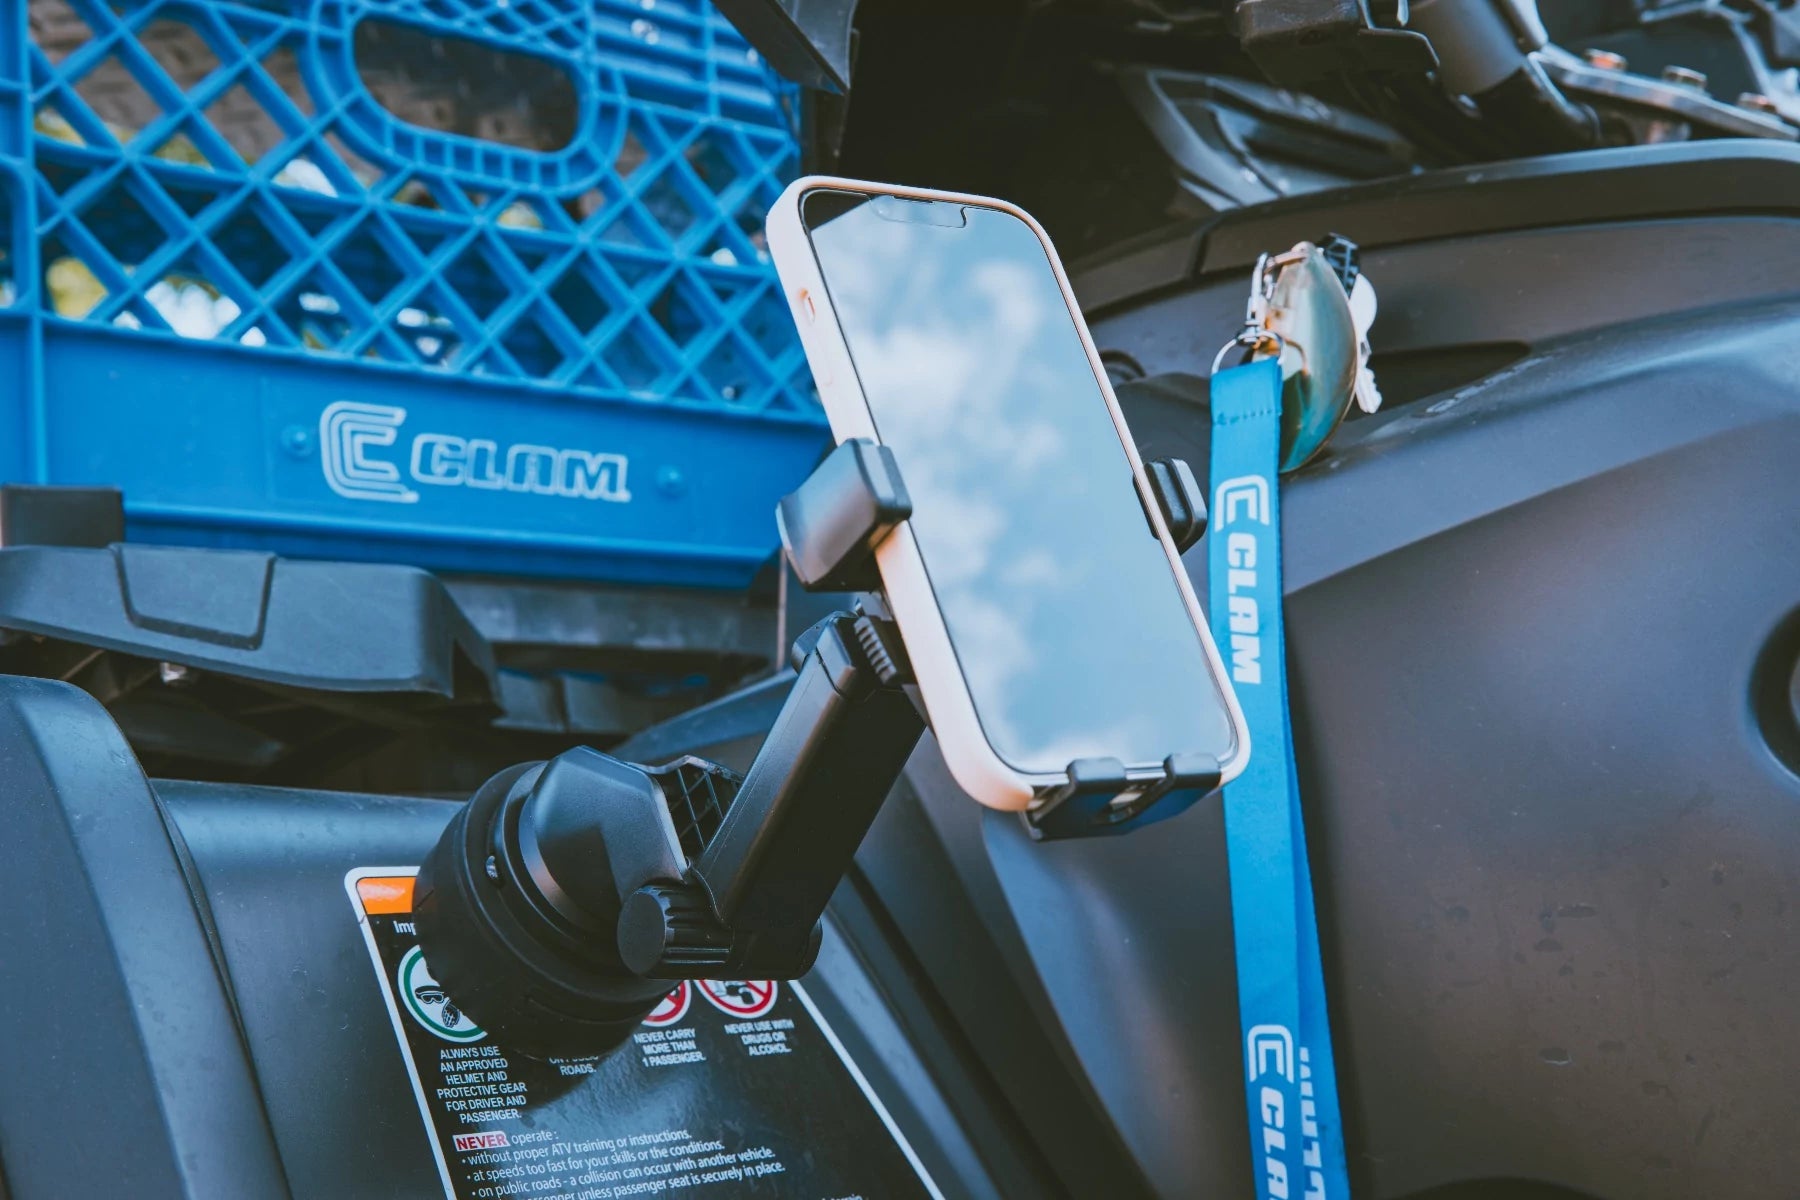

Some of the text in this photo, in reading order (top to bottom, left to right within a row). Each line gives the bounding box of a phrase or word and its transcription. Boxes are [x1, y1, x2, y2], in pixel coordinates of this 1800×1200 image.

[410, 433, 631, 502] CLAM
[1228, 532, 1261, 685] CLAM
[724, 1019, 794, 1035] NEVER USE WITH
[634, 1028, 696, 1044] NEVER CARRY
[741, 1031, 786, 1045] DRUGS OR
[440, 1046, 500, 1059] ALWAYS USE
[643, 1040, 697, 1055] MORE THAN
[440, 1058, 508, 1072] AN APPROVED
[650, 1052, 706, 1067] PASSENGER.
[560, 1063, 597, 1075] ROADS.
[445, 1070, 507, 1085] HELMET AND
[436, 1082, 528, 1099] PROTECTIVE GEAR
[445, 1095, 527, 1111] FOR DRIVER AND
[459, 1109, 522, 1123] PASSENGER.
[455, 1132, 508, 1150] NEVER
[467, 1128, 692, 1166] without proper ATV training or instructions.
[1261, 1086, 1290, 1200] CLA
[473, 1140, 725, 1181] at speeds too fast for your skills or the conditions.
[478, 1187, 494, 1198] on
[495, 1180, 530, 1198] public
[532, 1176, 561, 1190] roads
[579, 1168, 621, 1185] collision
[623, 1167, 642, 1178] can
[643, 1163, 672, 1176] occur
[673, 1157, 697, 1171] with
[698, 1152, 737, 1168] another
[738, 1146, 775, 1162] vehicle.
[578, 1187, 612, 1200] unless
[613, 1179, 667, 1200] passenger
[668, 1174, 691, 1189] seat
[692, 1172, 701, 1185] is
[700, 1166, 743, 1184] securely
[744, 1164, 756, 1177] in
[756, 1161, 786, 1178] place.
